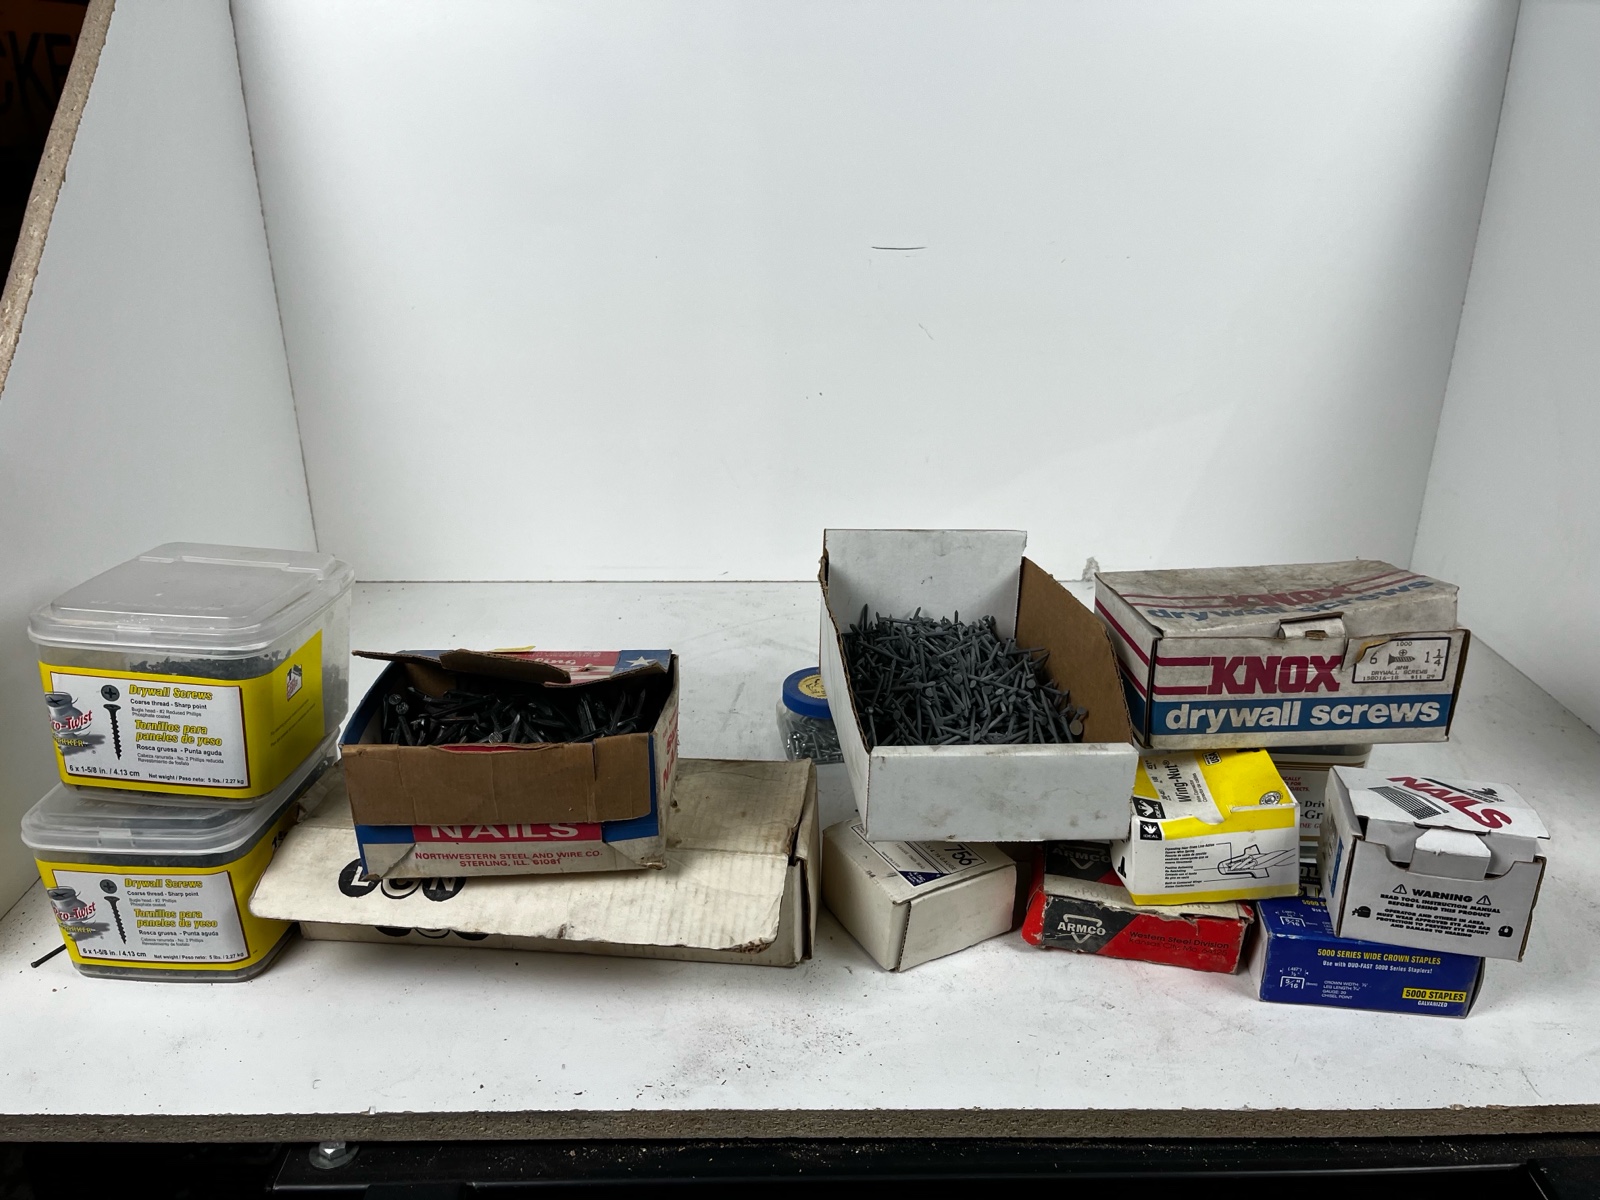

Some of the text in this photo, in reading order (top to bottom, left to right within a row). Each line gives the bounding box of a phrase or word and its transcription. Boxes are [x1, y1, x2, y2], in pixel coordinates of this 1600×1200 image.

[1146, 580, 1434, 621] drywall screws
[1222, 584, 1350, 608] KNOX
[1370, 652, 1378, 664] 6
[1207, 656, 1344, 694] KNOX
[129, 684, 213, 700] Drywall Screws
[174, 702, 191, 710] Sharp
[52, 710, 92, 731] ro-Twist
[1165, 701, 1440, 733] drywall screws
[134, 720, 208, 736] Tornillos para
[136, 732, 222, 747] paneles de yeso
[1210, 752, 1220, 763] USA
[81, 766, 97, 774] 1-5/8
[1386, 776, 1512, 828] NAILS
[1153, 804, 1162, 819] IDEAL
[430, 824, 579, 840] NAILS
[415, 852, 496, 860] NORTHWESTERN
[944, 842, 978, 866] 756
[1052, 848, 1111, 863] ARMCO
[125, 878, 203, 889] Drywall Screws
[1412, 888, 1473, 902] WARNING
[134, 909, 202, 920] Tornillos para
[1385, 908, 1416, 916] OPERATOR
[1422, 900, 1468, 909] INSTRUCTION
[1470, 906, 1501, 914] MANUAL
[136, 919, 176, 928] paneles
[194, 920, 218, 929] yeso
[1376, 916, 1413, 925] PROTECTION
[1058, 921, 1106, 936] ARMCO
[1129, 939, 1160, 947] Kansas
[1130, 932, 1166, 940] Western
[1194, 940, 1229, 948] Division
[1337, 950, 1361, 959] SERIES
[1363, 952, 1382, 960] WIDE
[1383, 953, 1409, 962] CROWN
[1411, 955, 1441, 965] STAPLES
[1405, 990, 1464, 1001] 5000 STAPLES
